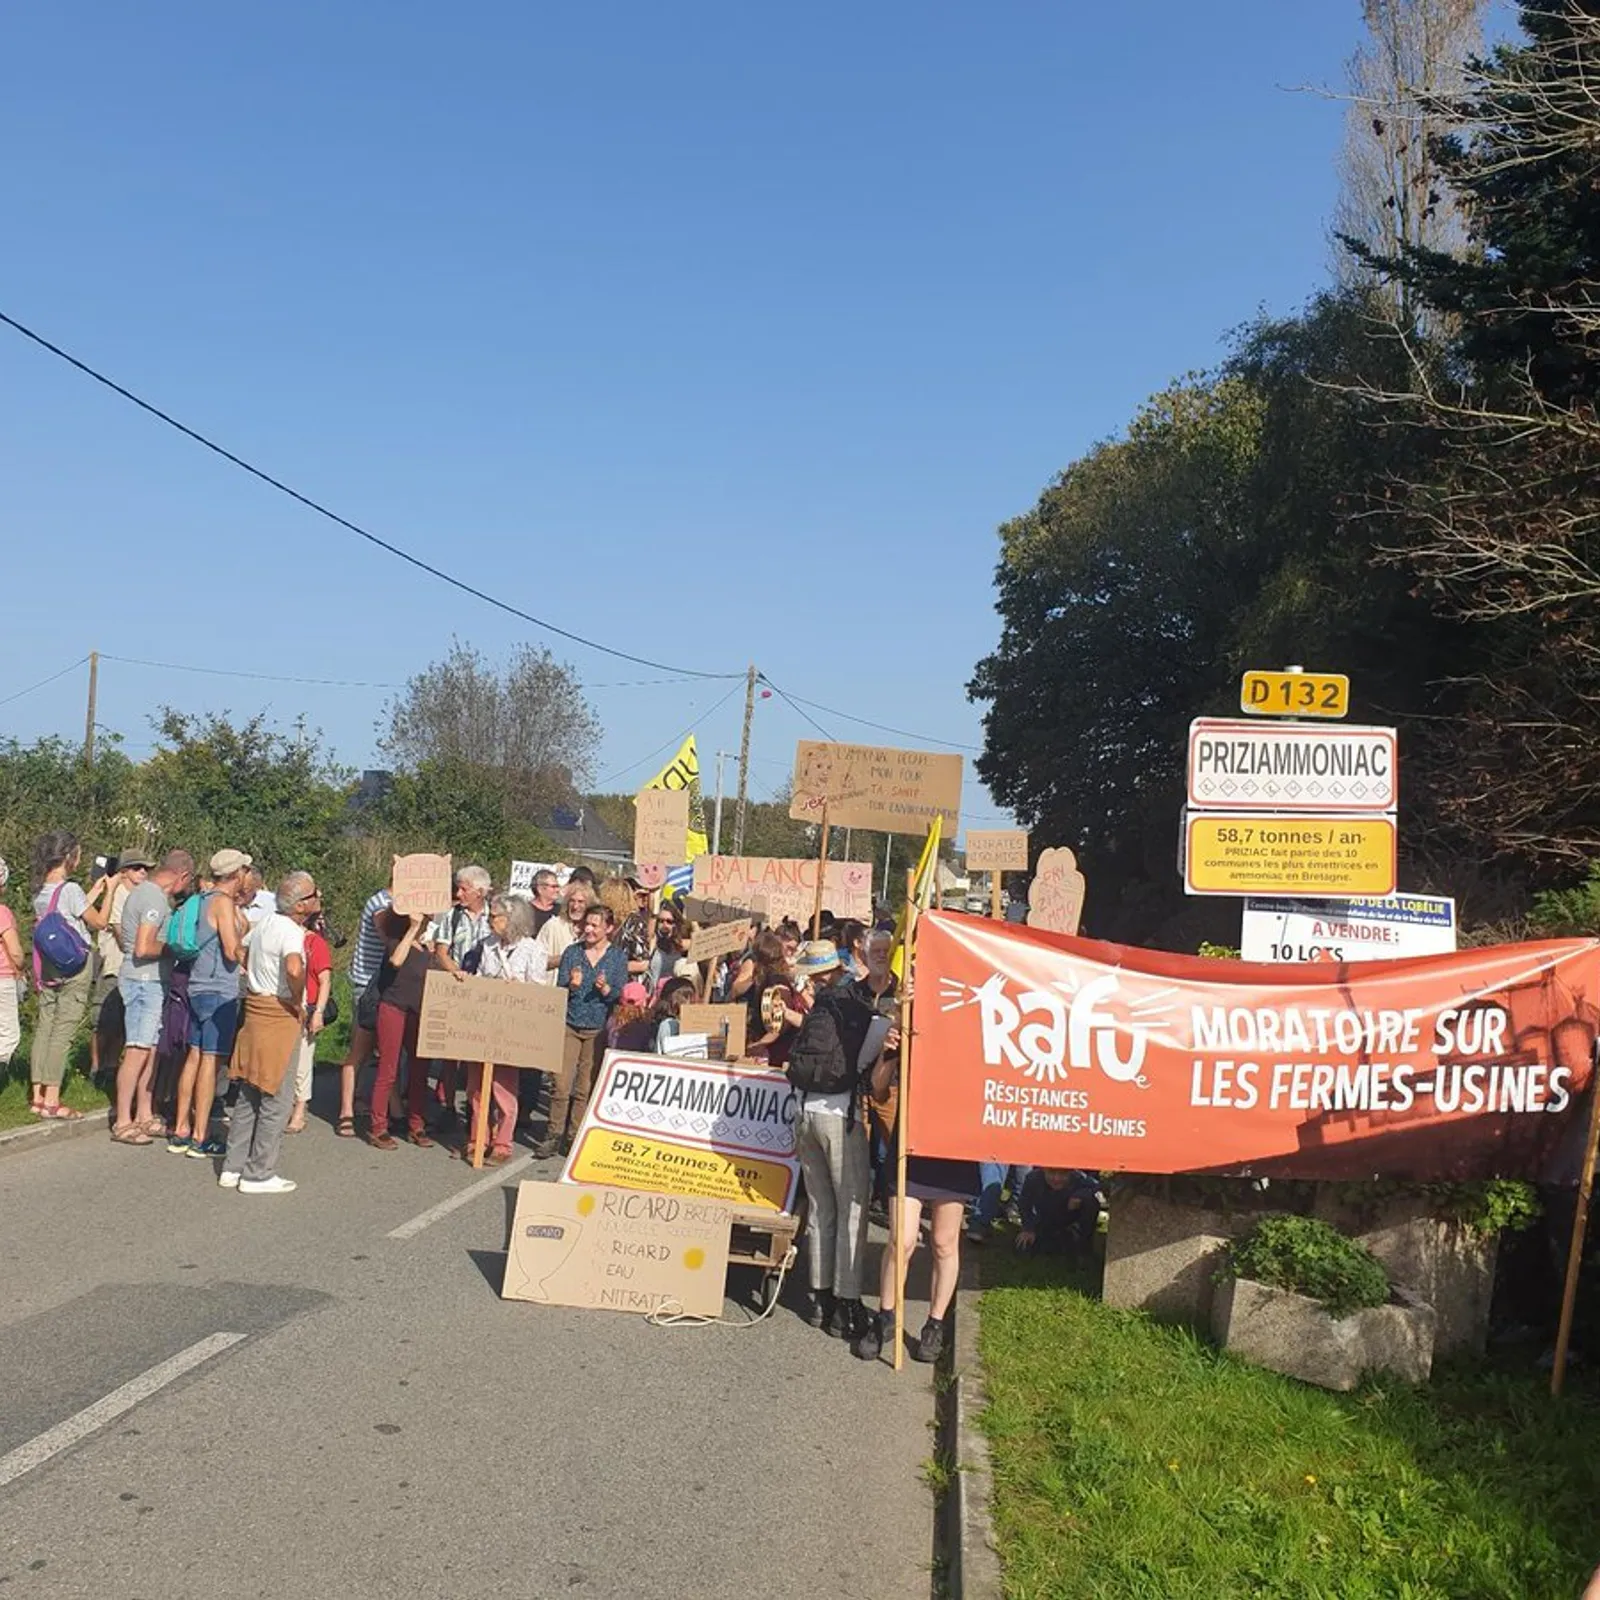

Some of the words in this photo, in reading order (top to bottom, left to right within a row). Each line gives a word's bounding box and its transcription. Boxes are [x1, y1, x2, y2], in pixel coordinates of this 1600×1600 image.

[1251, 680, 1270, 704] D
[1280, 681, 1340, 708] 132
[1199, 741, 1388, 777] PRIZIAMMONIAC
[1217, 828, 1254, 845] 58,7
[1260, 830, 1323, 844] tonnes
[1328, 830, 1335, 843] /
[1204, 861, 1261, 869] communes
[1263, 860, 1279, 869] les
[1281, 860, 1304, 871] plus
[1307, 861, 1363, 870] émettrices
[1225, 848, 1268, 857] PRIZIAC
[1271, 848, 1288, 857] fait
[1290, 848, 1321, 860] partie
[1322, 849, 1342, 858] des
[1345, 850, 1357, 858] 10
[1230, 871, 1282, 880] ammoniac
[1301, 872, 1352, 883] Bretagne.
[1312, 922, 1323, 936] A
[1328, 924, 1391, 941] VENDRE
[1270, 944, 1293, 960] 10
[1191, 1005, 1422, 1054] MORATOIRE
[1431, 1007, 1507, 1056] SUR
[609, 1069, 797, 1125] PRIZIAMMONIAC
[984, 1080, 1088, 1109] RÉSISTANCES
[1190, 1060, 1259, 1109] LES
[1269, 1063, 1571, 1113] FERMES-USINES
[1022, 1108, 1147, 1138] FERMES-USINES
[611, 1139, 651, 1158] 58,7
[655, 1150, 718, 1173] tonnes
[723, 1162, 732, 1174] /
[601, 1191, 680, 1222] RICARD
[611, 1240, 671, 1261] RICARD
[606, 1264, 635, 1280] EAU
